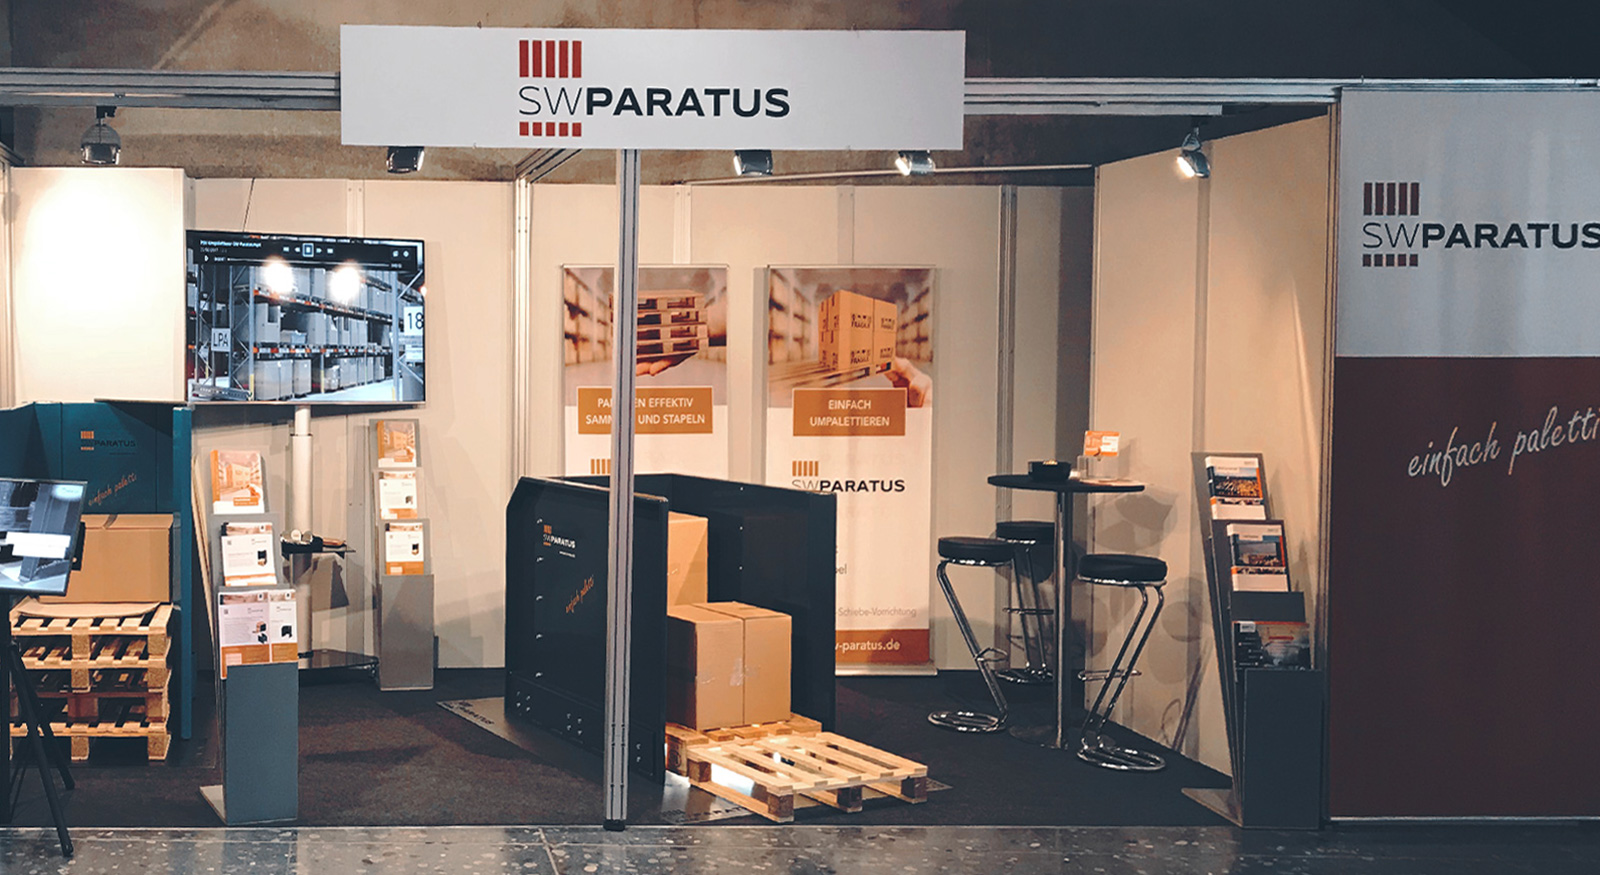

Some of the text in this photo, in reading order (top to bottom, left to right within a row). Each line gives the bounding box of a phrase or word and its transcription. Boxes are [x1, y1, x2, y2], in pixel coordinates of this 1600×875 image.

[519, 86, 790, 118] SWPARATUS
[1362, 222, 1600, 249] SWPARATUS
[408, 312, 424, 330] 18
[213, 332, 229, 348] LPA
[648, 397, 694, 408] EFFEKTIV
[828, 399, 872, 410] EINFACH
[638, 414, 661, 425] UND
[663, 414, 705, 424] STAPELN
[809, 416, 890, 427] UMPALETTIEREN
[1407, 421, 1501, 487] einfach
